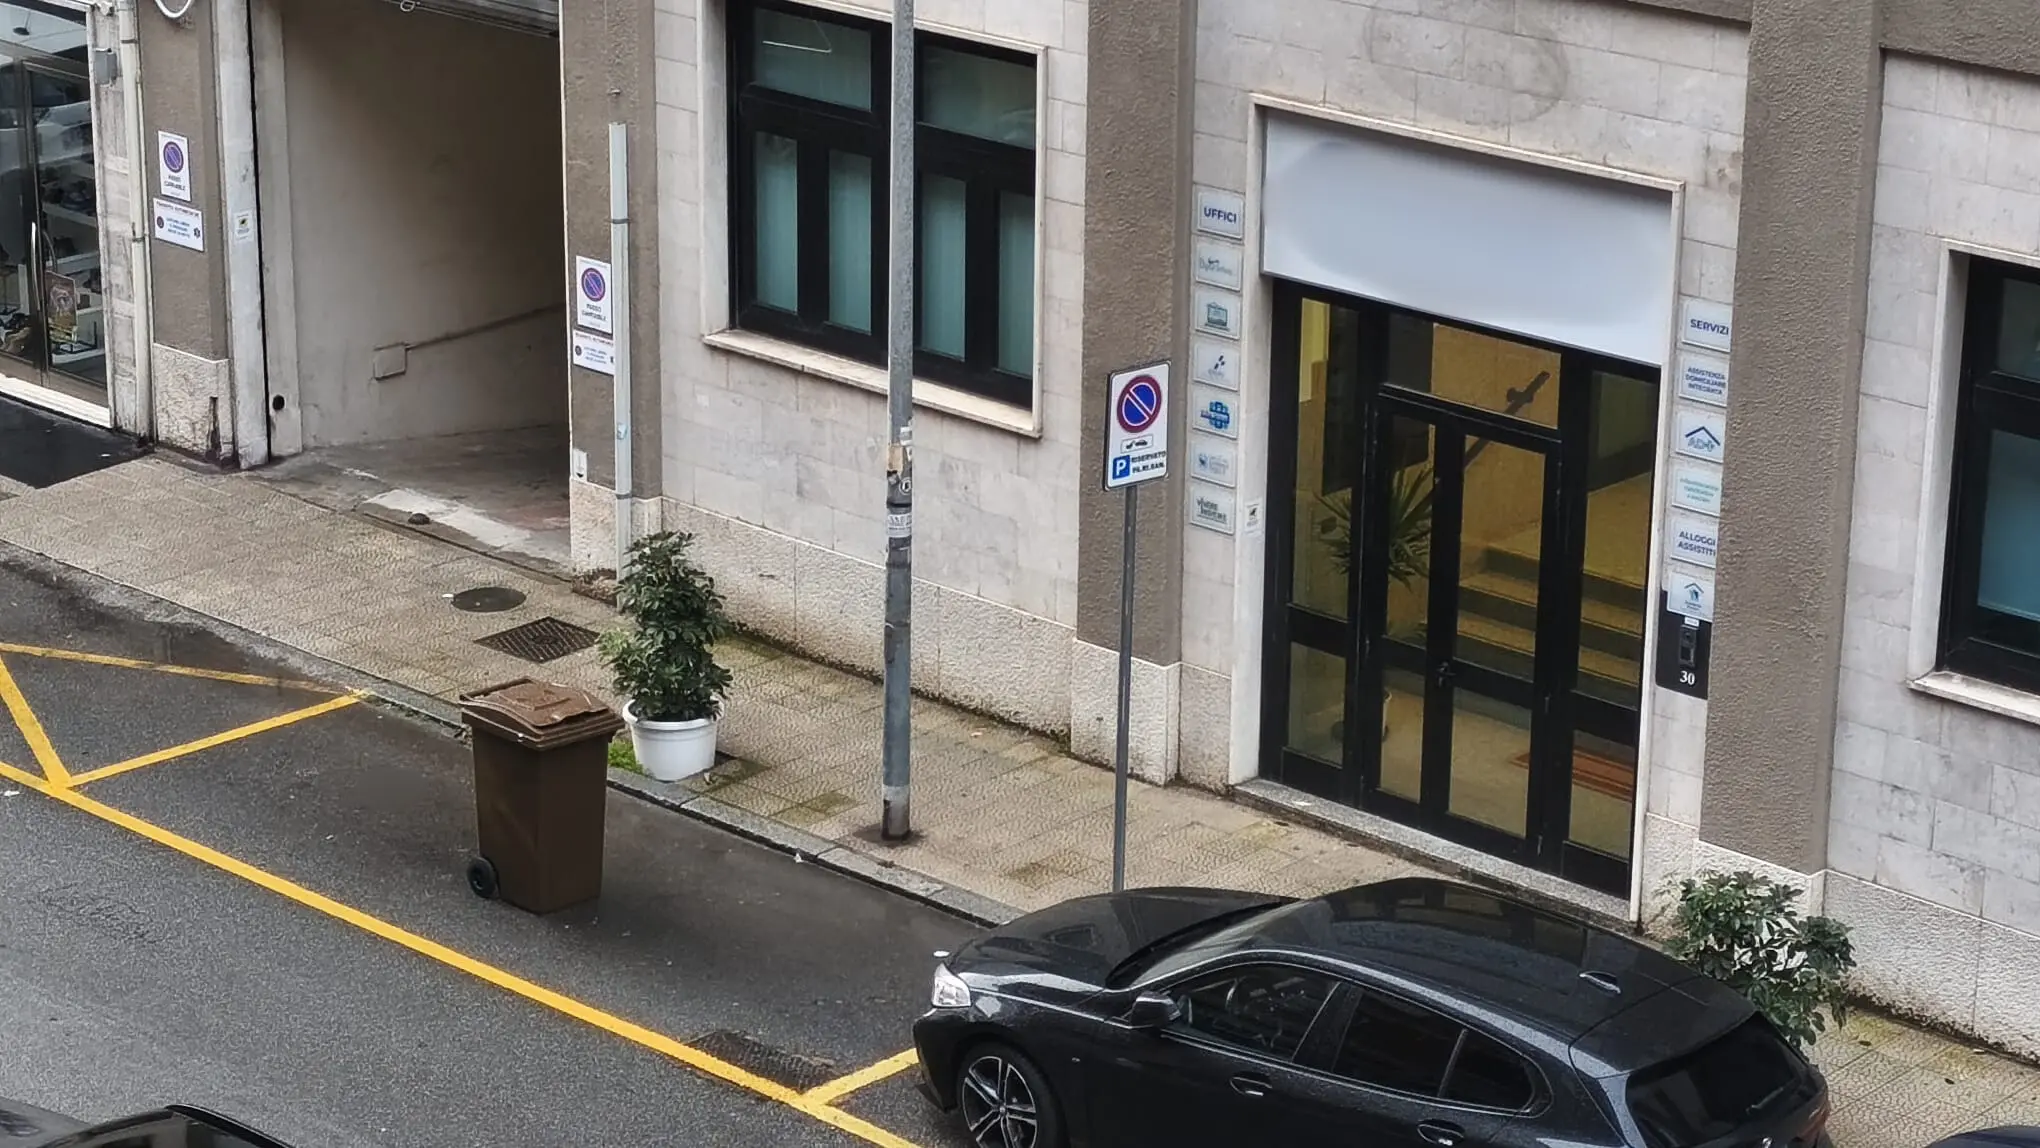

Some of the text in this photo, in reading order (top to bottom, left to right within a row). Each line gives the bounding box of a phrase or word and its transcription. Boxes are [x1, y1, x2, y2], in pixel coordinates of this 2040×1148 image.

[1203, 206, 1237, 223] UFFICI
[1690, 318, 1729, 335] SERVIZI
[1687, 366, 1725, 380] ASSISTENZA
[1131, 450, 1167, 463] RISERVATO
[1116, 459, 1126, 476] P
[1679, 531, 1716, 546] ALLOGGI
[1678, 541, 1716, 556] ASSISTITI
[1680, 670, 1696, 686] 30
